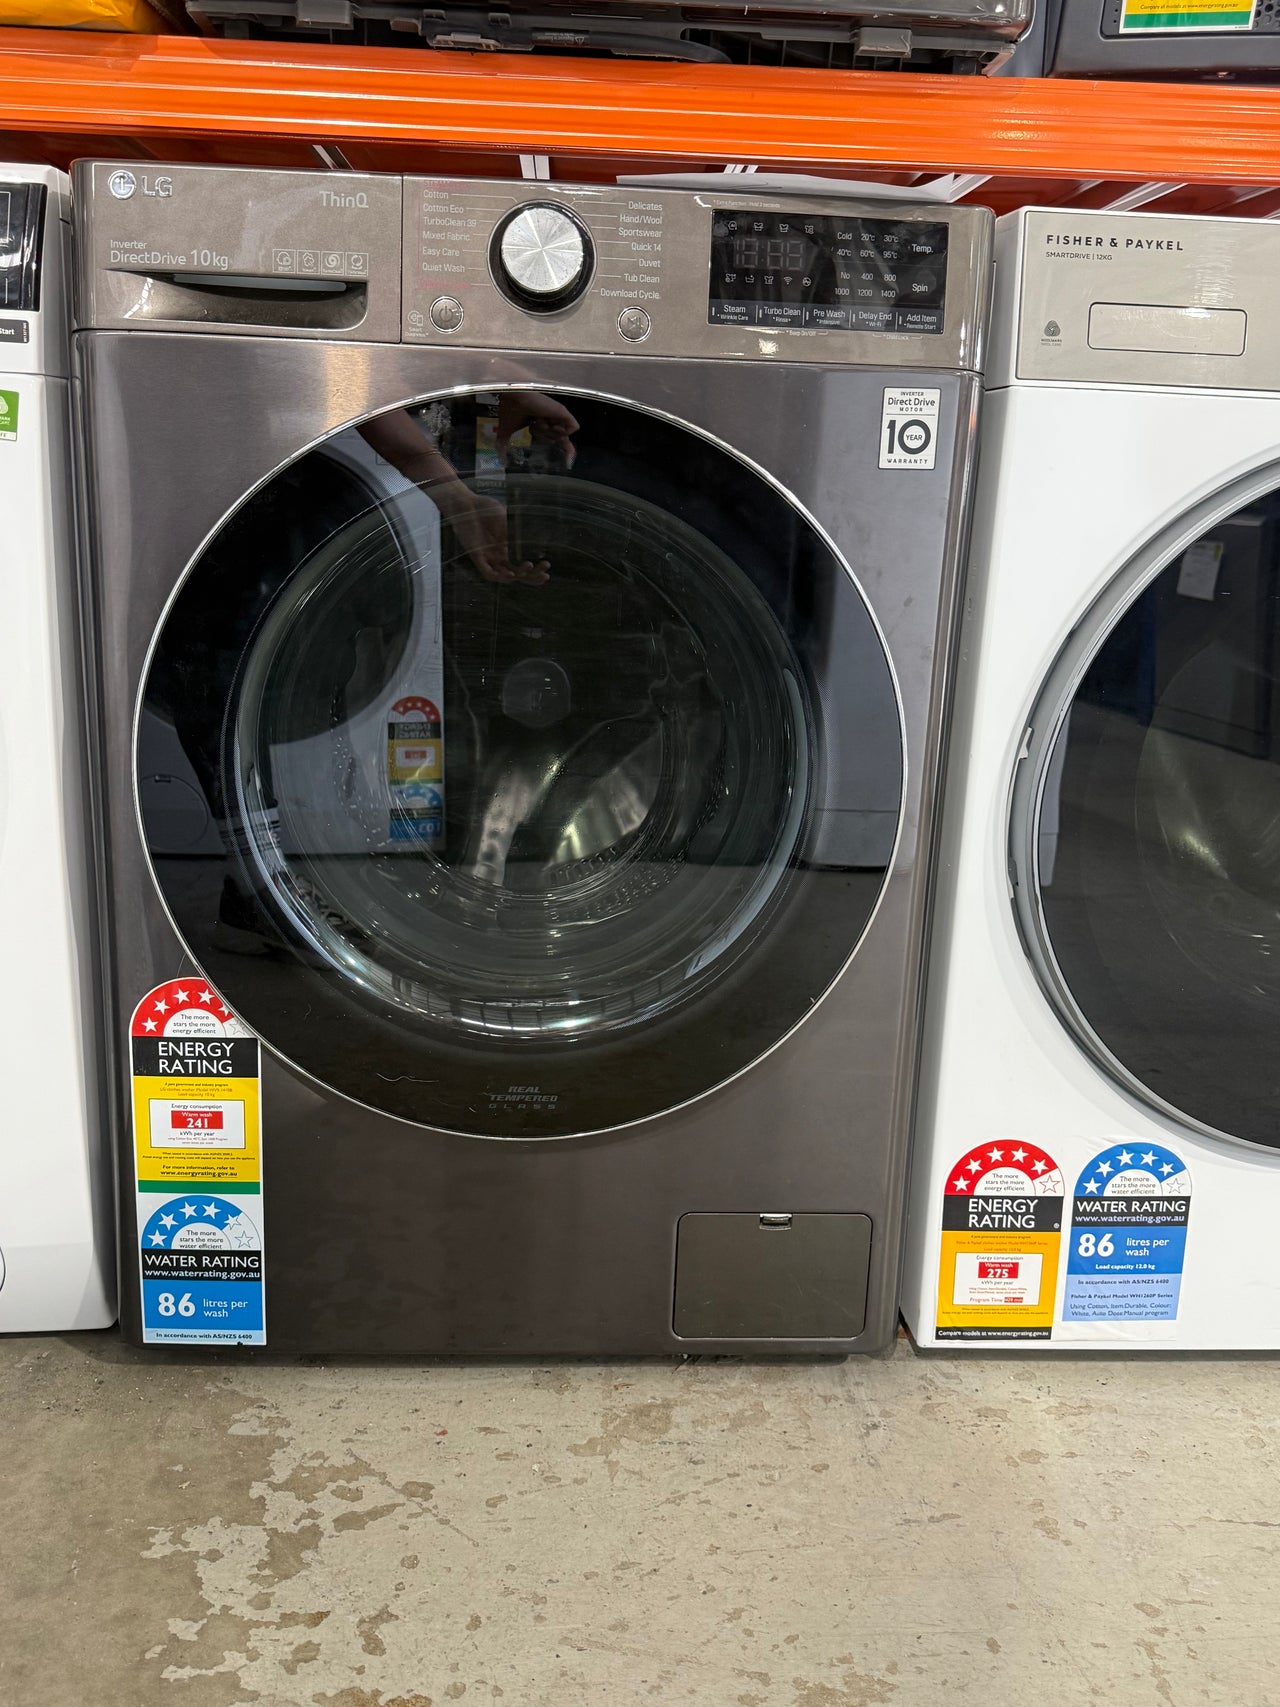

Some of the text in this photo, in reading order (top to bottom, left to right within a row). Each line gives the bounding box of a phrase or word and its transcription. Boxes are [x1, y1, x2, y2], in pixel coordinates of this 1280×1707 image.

[142, 176, 173, 197] LG
[319, 190, 369, 208] ThinQ
[423, 190, 448, 199] Cotton
[423, 203, 464, 213] Cotton Eco
[628, 201, 662, 211] Delicates
[423, 216, 477, 228] TurboClean 39
[620, 214, 662, 224] Hand/Wool
[422, 230, 470, 241] Mixed Fabric
[618, 227, 662, 238] Sportswear
[836, 232, 852, 240] Cold
[110, 240, 148, 249] Inverter
[631, 242, 662, 252] Quick 14
[1046, 234, 1184, 252] FISHER & PAYKEL
[422, 246, 460, 256] Easy Care
[912, 244, 934, 254] Temp.
[110, 250, 187, 265] DirectDrive
[1046, 251, 1090, 260] SMARTDRIVE
[422, 262, 466, 272] Quiet Wash
[638, 258, 661, 268] Duvet
[624, 273, 660, 283] Tub Clean
[840, 272, 850, 280] No
[834, 288, 850, 296] 1000
[881, 290, 896, 298] 1400
[912, 283, 928, 293] Spin
[600, 288, 660, 300] Download Cycle
[723, 304, 746, 313] Steam
[764, 306, 801, 316] Turbo Clean
[813, 309, 846, 318] Pre Wash
[858, 312, 892, 320] Delay End
[906, 314, 937, 322] Add Item
[888, 397, 936, 406] Direct Drive
[886, 419, 932, 455] 10
[158, 1042, 234, 1057] ENERGY
[158, 1059, 232, 1074] RATING
[490, 1094, 559, 1102] TEMPERED
[186, 1118, 208, 1128] 241
[968, 1198, 1039, 1213] ENERGY
[1076, 1200, 1186, 1213] WATER RATING
[968, 1214, 1036, 1228] RATING
[1074, 1214, 1185, 1224] www.waterrating.gov.au
[1078, 1233, 1114, 1258] 86
[1126, 1237, 1170, 1248] litres per
[1125, 1248, 1150, 1256] wash
[144, 1254, 259, 1268] WATER RATING
[144, 1270, 260, 1280] www.waterrating.gov.au
[987, 1268, 1009, 1278] 275
[158, 1292, 196, 1318] 86
[203, 1298, 248, 1310] litres per
[203, 1308, 228, 1318] wash
